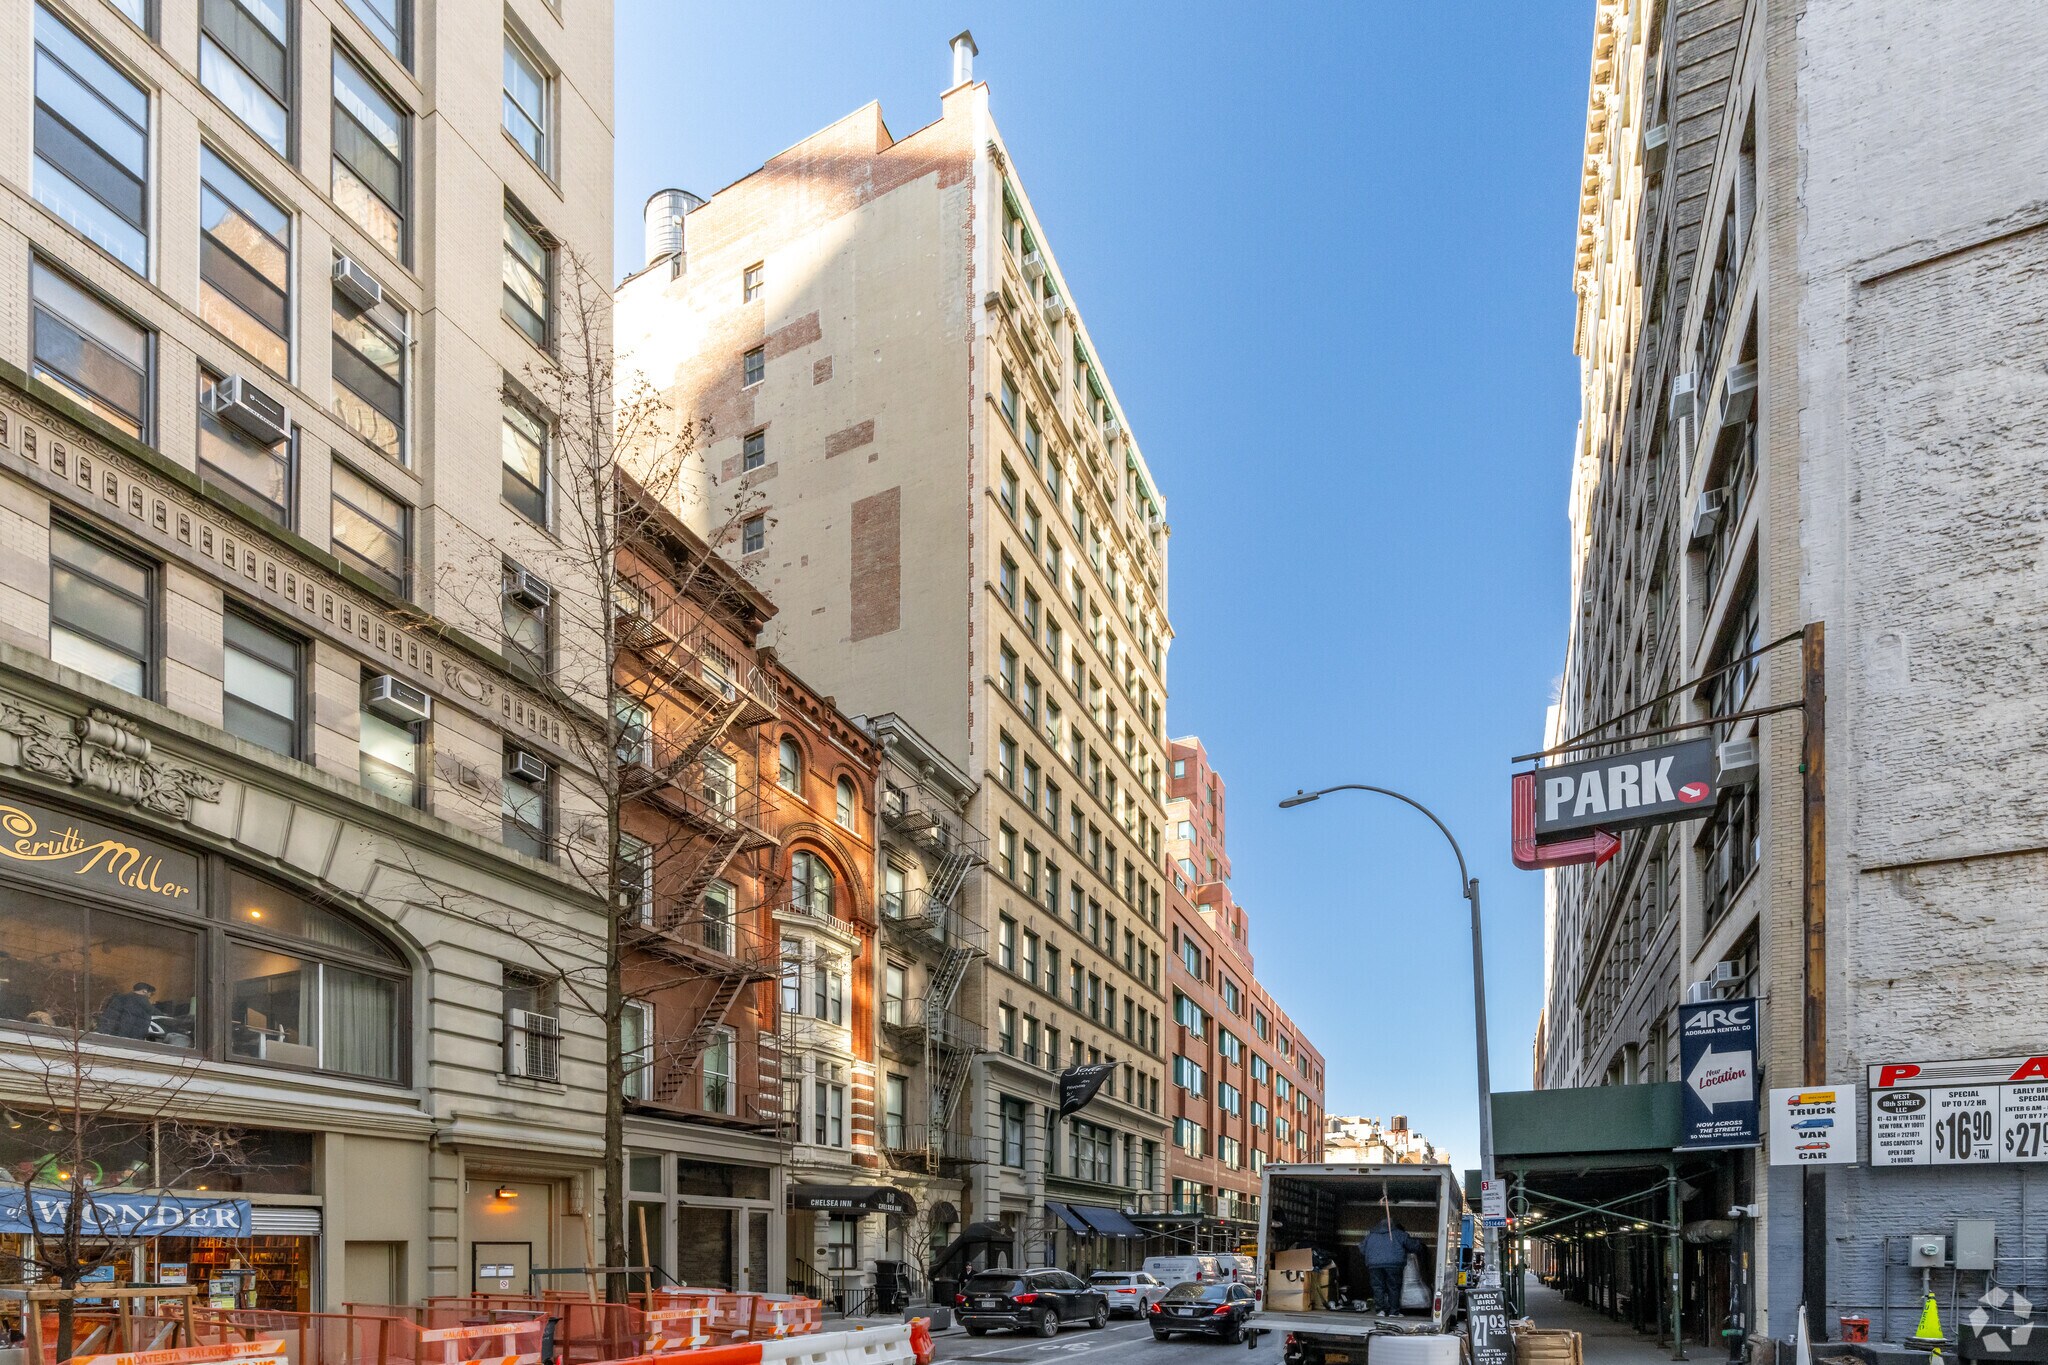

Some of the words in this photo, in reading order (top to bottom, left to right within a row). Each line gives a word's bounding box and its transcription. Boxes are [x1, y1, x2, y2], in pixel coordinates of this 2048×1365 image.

[1545, 756, 1676, 822] PARK
[75, 840, 189, 899] Miller
[1685, 1006, 1750, 1029] ARC
[1706, 1069, 1721, 1077] New
[1699, 1067, 1746, 1089] Location
[2013, 1087, 2035, 1095] EARLY
[1788, 1107, 1836, 1116] TRUCK
[1799, 1131, 1827, 1139] VAN
[1799, 1151, 1827, 1160] CAR
[810, 1199, 839, 1207] CHELSEA
[839, 1199, 853, 1207] INN
[878, 1203, 895, 1211] CHELSEA
[6, 1204, 27, 1219] of
[35, 1200, 240, 1229] WONDER
[116, 1352, 181, 1365] MALATESTA
[242, 1343, 262, 1354] INC
